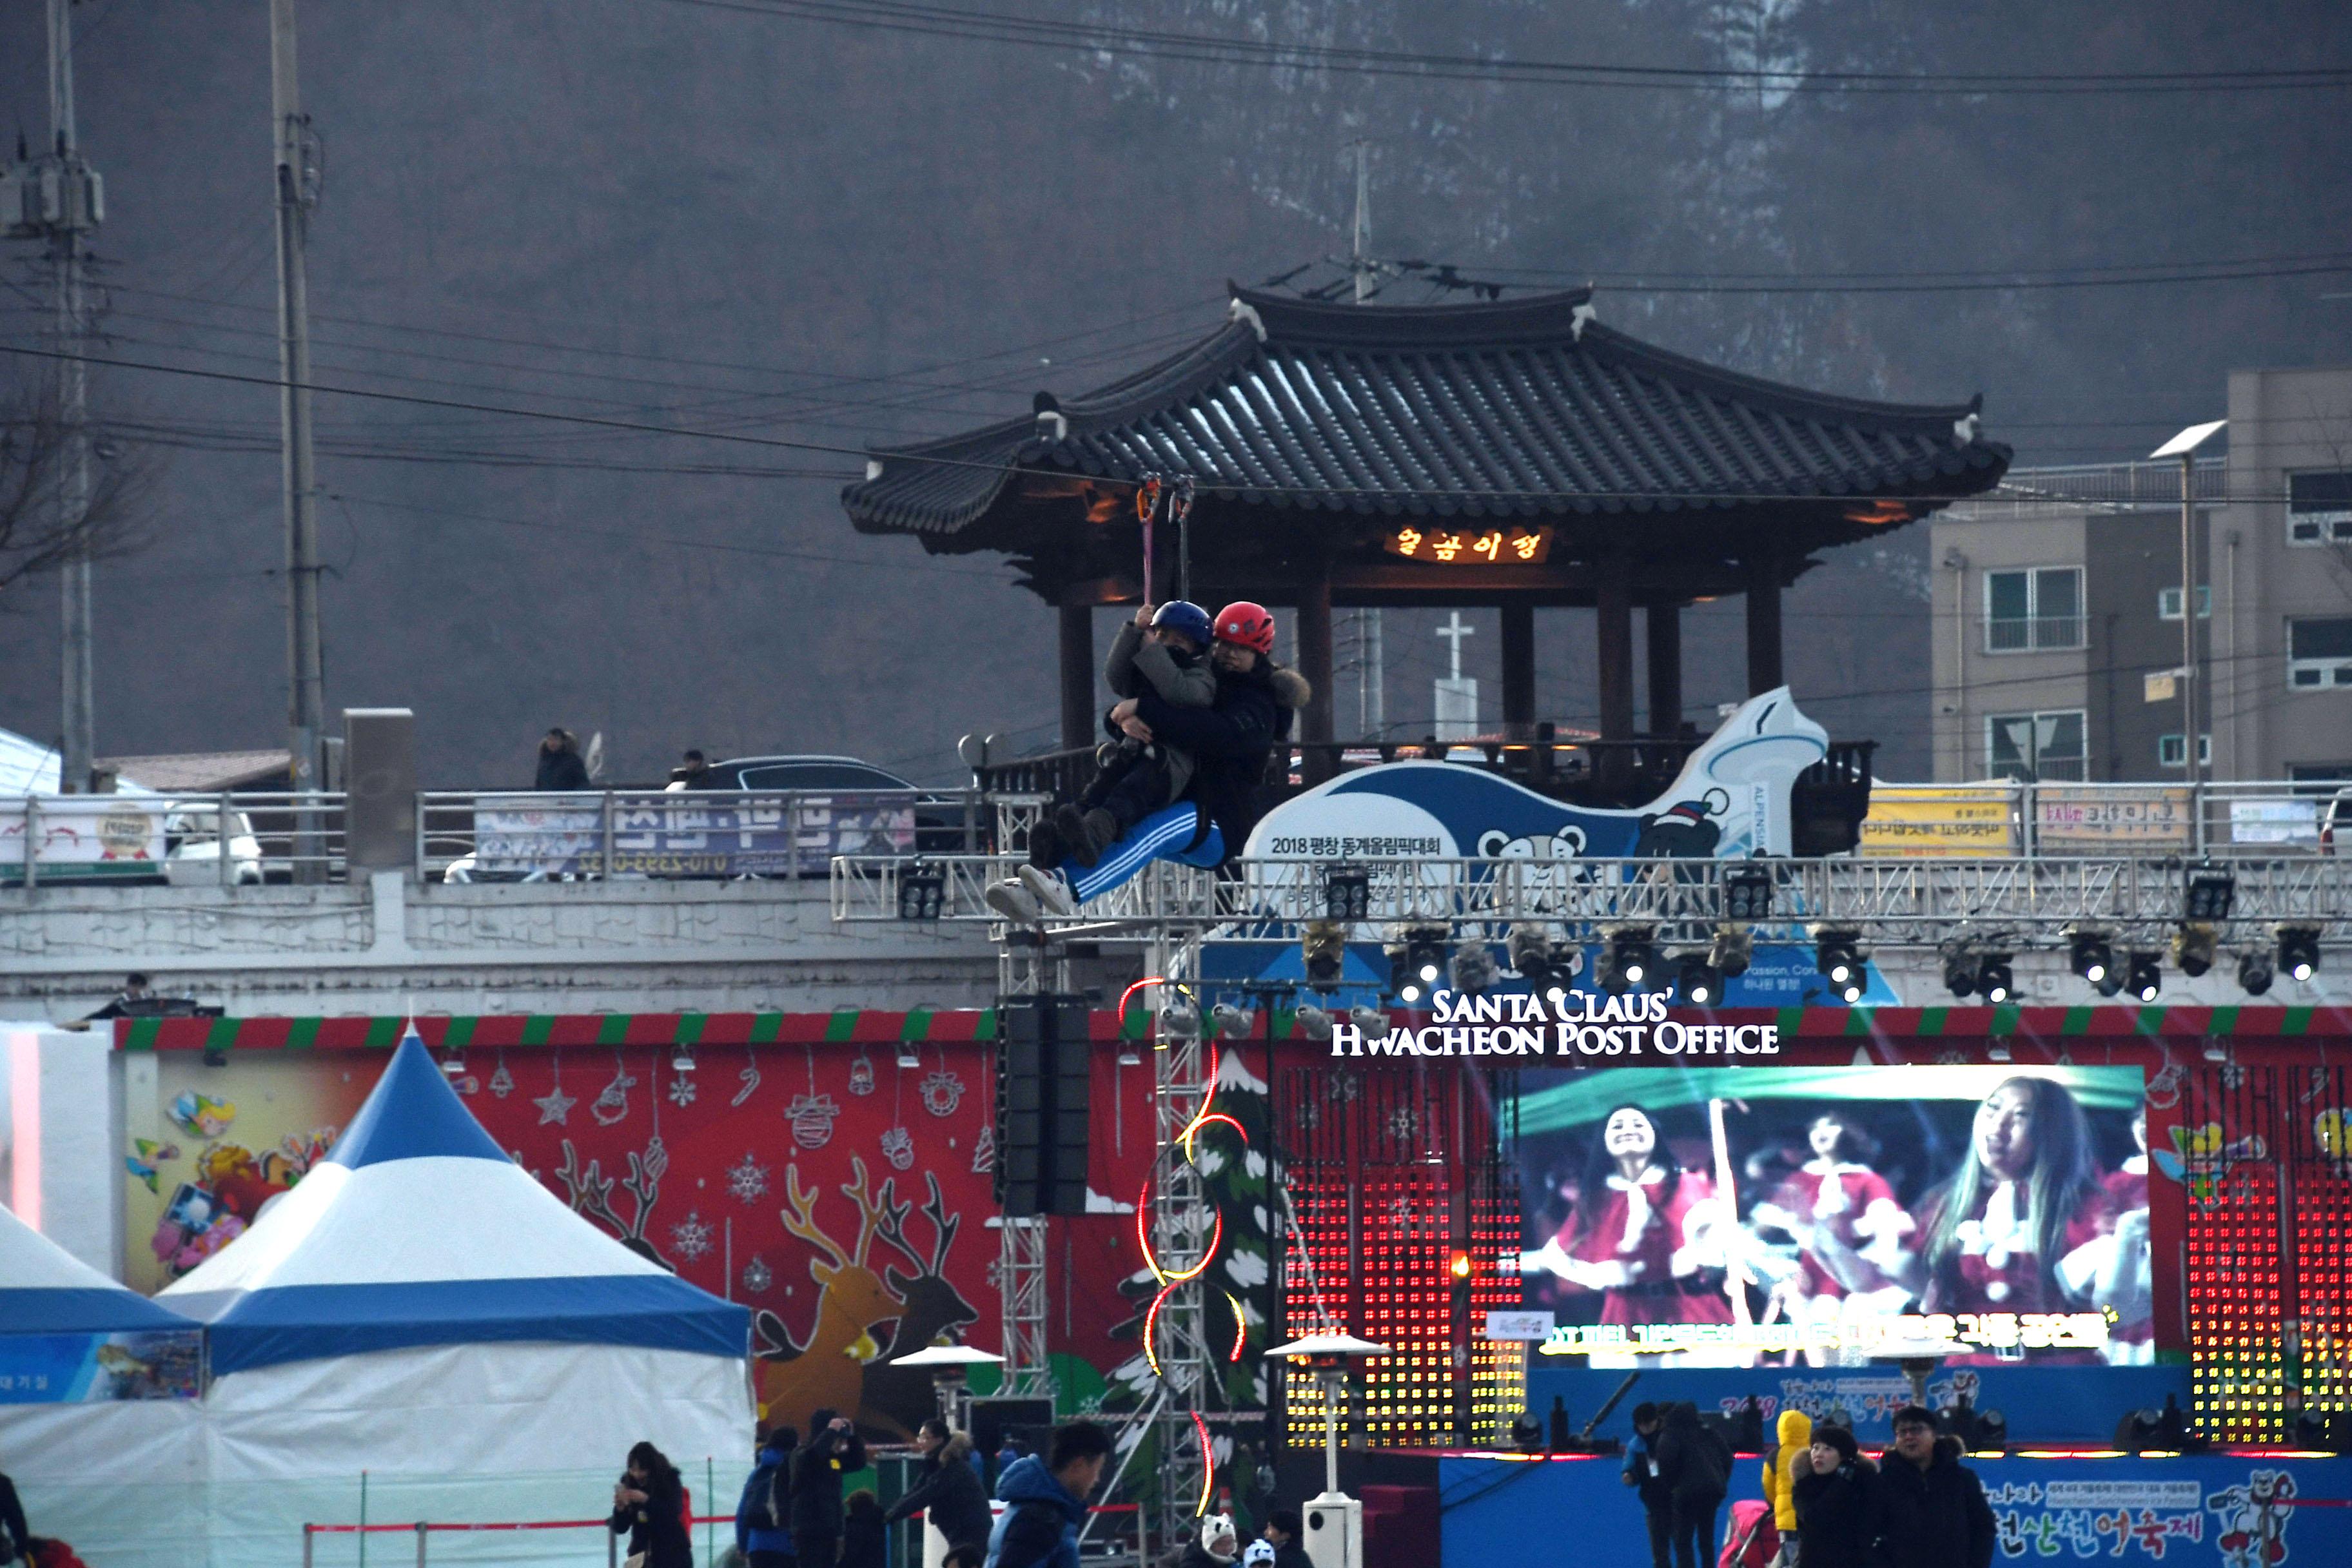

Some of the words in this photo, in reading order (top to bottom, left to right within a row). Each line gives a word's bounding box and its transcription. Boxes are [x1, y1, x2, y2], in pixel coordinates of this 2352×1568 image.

[1272, 838, 1307, 854] 2018
[1310, 837, 1338, 856] 평창
[1341, 837, 1441, 856] 동계올림픽대회
[1432, 989, 1548, 1024] SANTA
[1331, 1024, 1544, 1056] HWACHEON
[1556, 1024, 1647, 1055] POST
[1654, 1023, 1779, 1055] OFFICE
[1994, 1509, 2204, 1559] 천산천어축제
